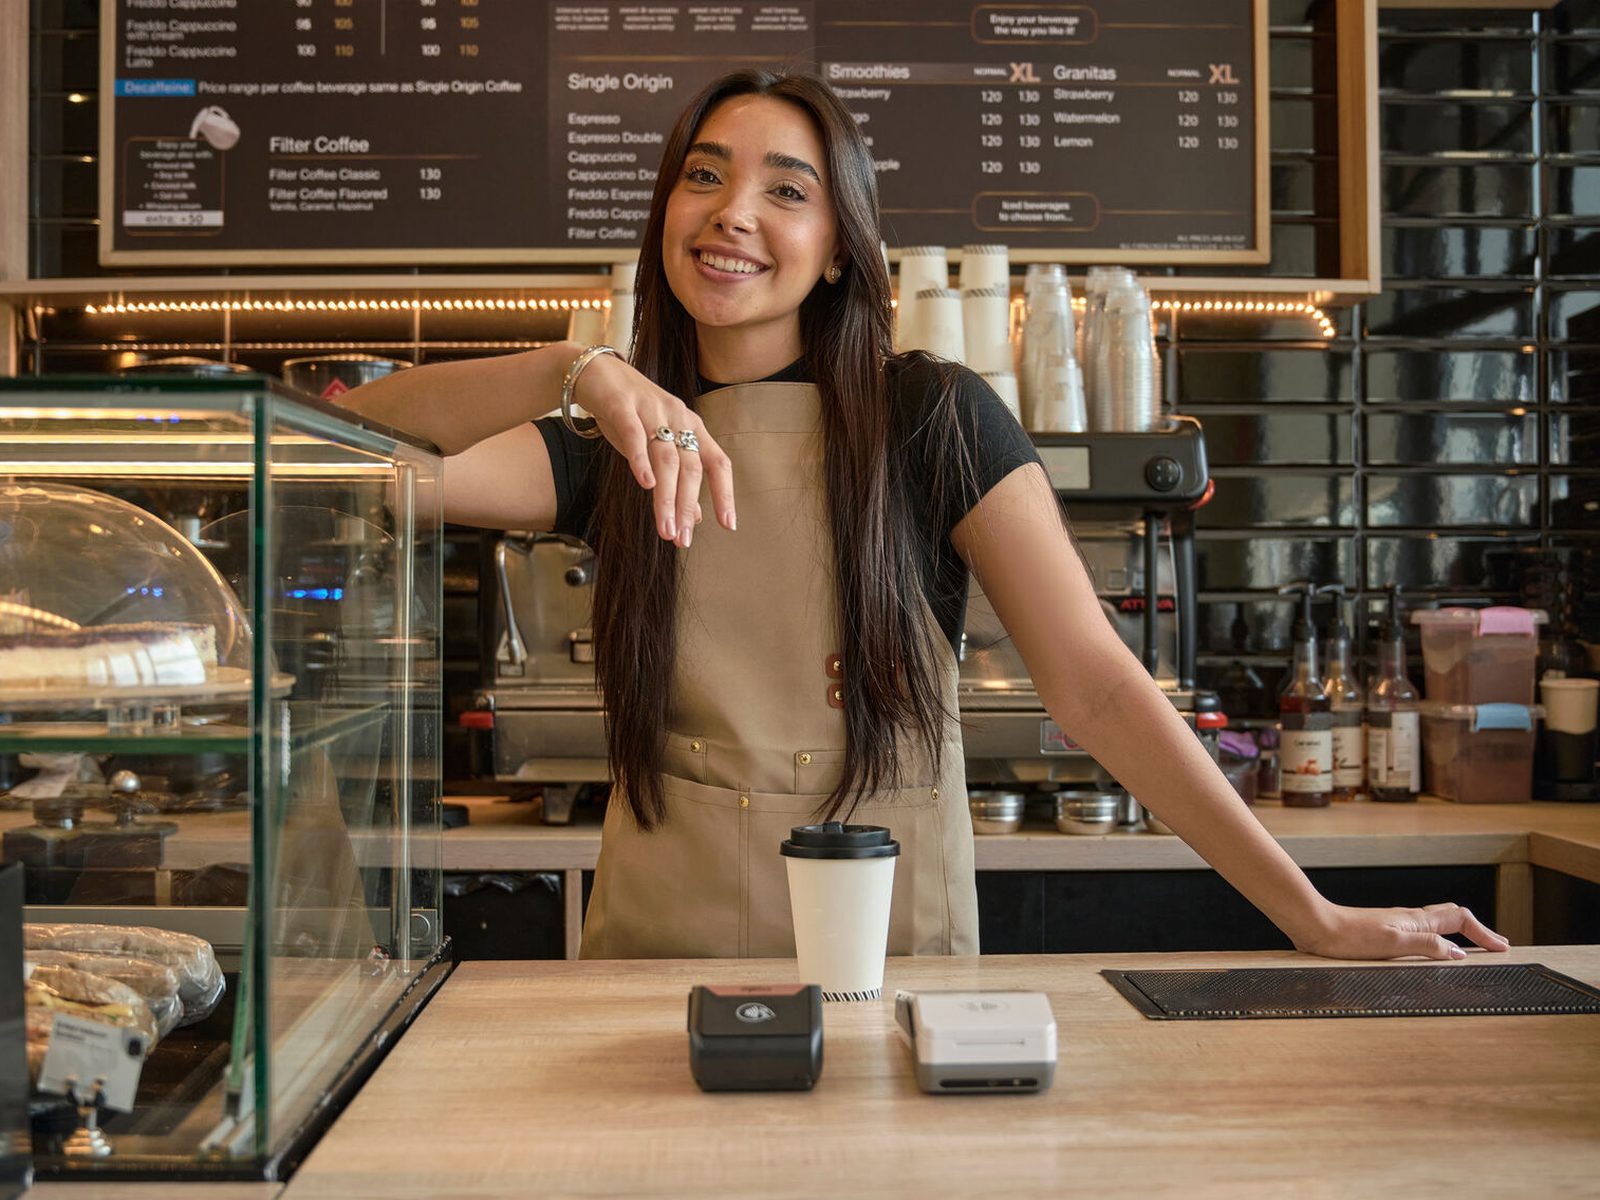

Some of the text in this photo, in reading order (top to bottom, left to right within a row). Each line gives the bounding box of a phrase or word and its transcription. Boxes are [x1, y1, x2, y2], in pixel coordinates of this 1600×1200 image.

[126, 19, 237, 32] Freddo Cappuccino
[1037, 15, 1079, 25] beverage
[126, 45, 237, 58] Freddo Cappuccino
[297, 44, 354, 57] 100 110
[421, 44, 479, 56] 100 110
[829, 64, 911, 80] Smoothies
[1009, 63, 1040, 83] XL
[1053, 65, 1117, 80] Granitas
[1209, 64, 1239, 84] XL
[198, 82, 226, 93] Price
[228, 83, 259, 96] range
[262, 83, 279, 96] per
[281, 80, 315, 93] coffee
[317, 80, 367, 96] beverage
[369, 82, 398, 93] same
[400, 82, 414, 93] as
[416, 80, 449, 96] Single
[451, 80, 484, 96] Origin
[485, 80, 522, 93] Coffee
[568, 73, 674, 93] Single Origin
[981, 91, 1003, 103] 120
[1019, 91, 1040, 103] 130
[1053, 89, 1238, 104] Strawberry 120 130
[568, 113, 620, 126] Espresso
[981, 114, 1040, 127] 120 130
[1053, 112, 1238, 128] Watermelon 120 130
[269, 136, 370, 154] Filter Coffee
[568, 132, 663, 145] Espresso Double
[981, 135, 1040, 148] 120 130
[1053, 136, 1238, 150] Lemon 120 130
[568, 152, 637, 164] Cappuccino
[981, 161, 1040, 174] 120 130
[269, 168, 441, 181] Filter Coffee Classic 130
[568, 170, 636, 182] Cappuccino
[269, 188, 441, 200] Filter Coffee Flavored 130
[568, 189, 608, 200] Freddo
[568, 208, 608, 219] Freddo
[568, 228, 637, 239] Filter Coffee
